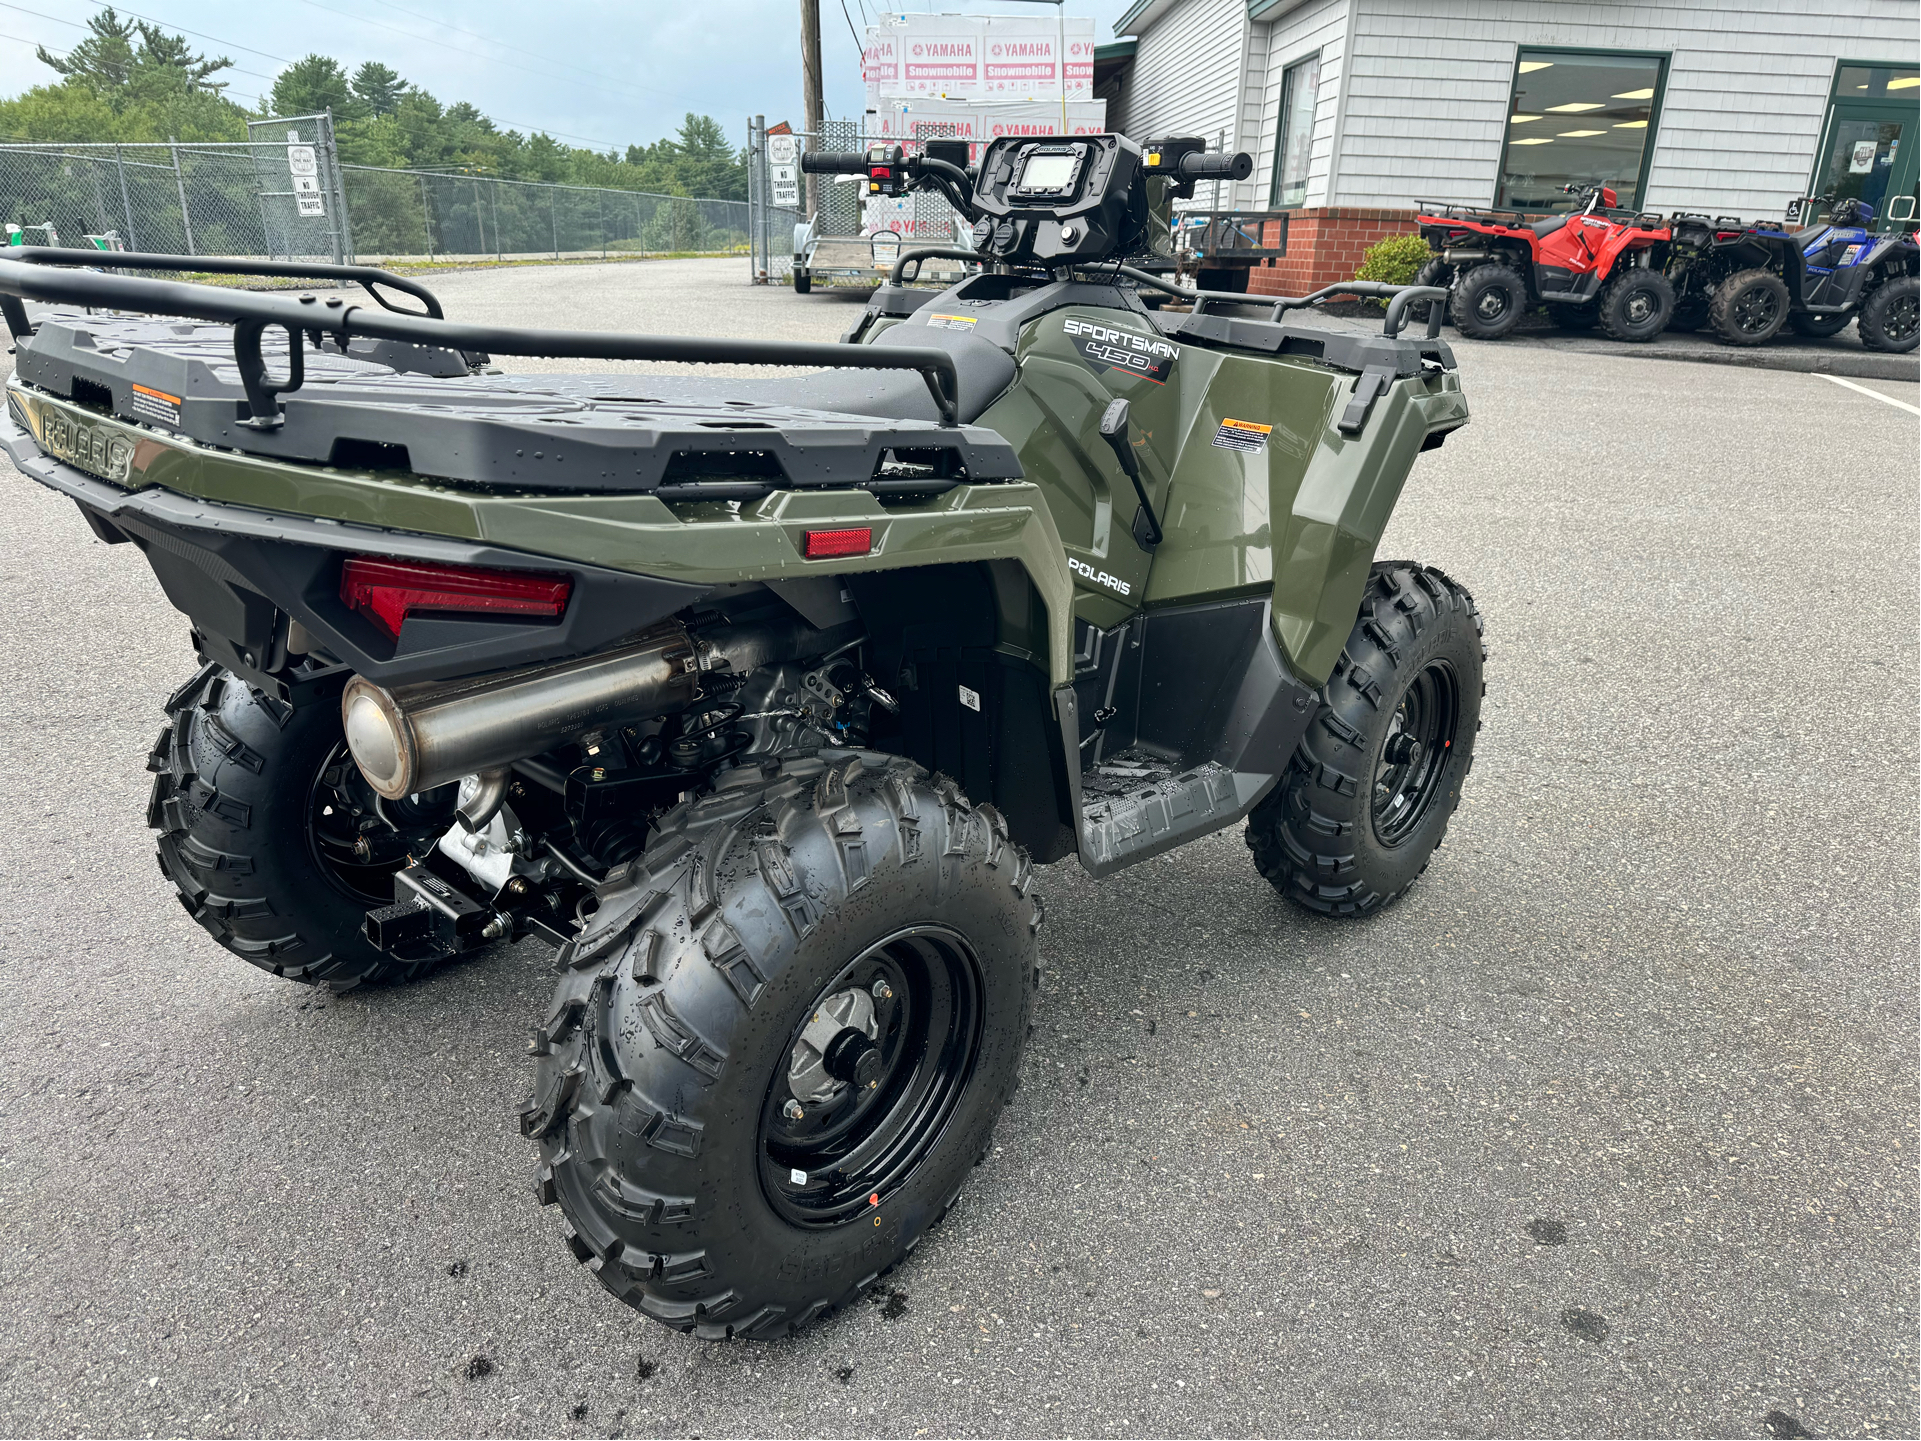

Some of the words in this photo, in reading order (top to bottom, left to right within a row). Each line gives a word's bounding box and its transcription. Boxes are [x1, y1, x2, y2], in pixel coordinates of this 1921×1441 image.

[925, 43, 972, 57] YAMAHA
[1004, 43, 1051, 57] YAMAHA
[908, 66, 973, 76] Snowmobile
[987, 65, 1052, 76] Snowmobile
[1006, 124, 1054, 135] YAMAHA
[780, 171, 787, 179] NO
[774, 181, 796, 189] THROUGH
[298, 191, 319, 200] THROUGH
[776, 190, 795, 199] TRAFFIC
[300, 201, 320, 210] TRAFFIC
[1063, 319, 1181, 361] SPORTSMAN
[1085, 341, 1151, 371] 450
[1238, 422, 1261, 431] WARNING
[1068, 557, 1131, 596] POLARIS
